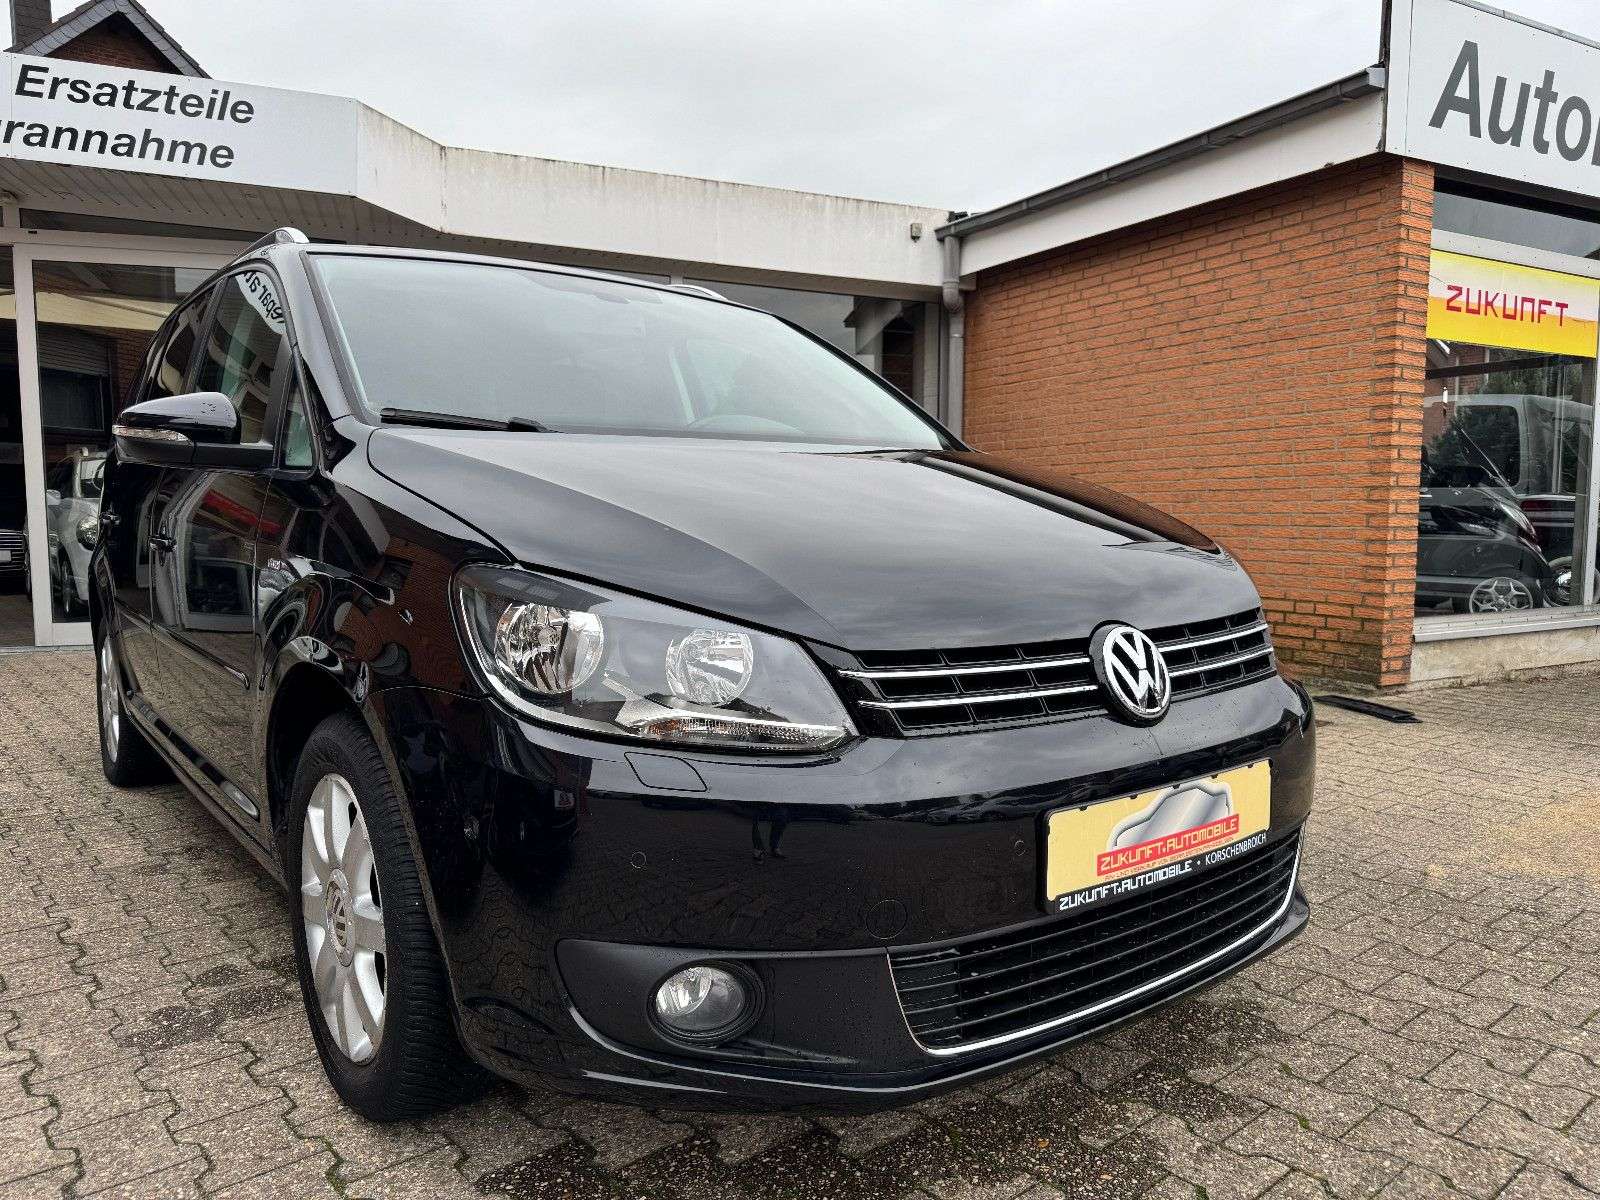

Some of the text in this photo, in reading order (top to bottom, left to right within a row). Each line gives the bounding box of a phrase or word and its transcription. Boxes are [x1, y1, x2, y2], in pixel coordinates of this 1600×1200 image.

[14, 63, 255, 124] Ersatzteile
[0, 119, 235, 169] rannahme
[1446, 284, 1569, 327] ZUKUNFT
[1103, 626, 1169, 714] VW
[1205, 832, 1267, 866] KORSCHENBROICH
